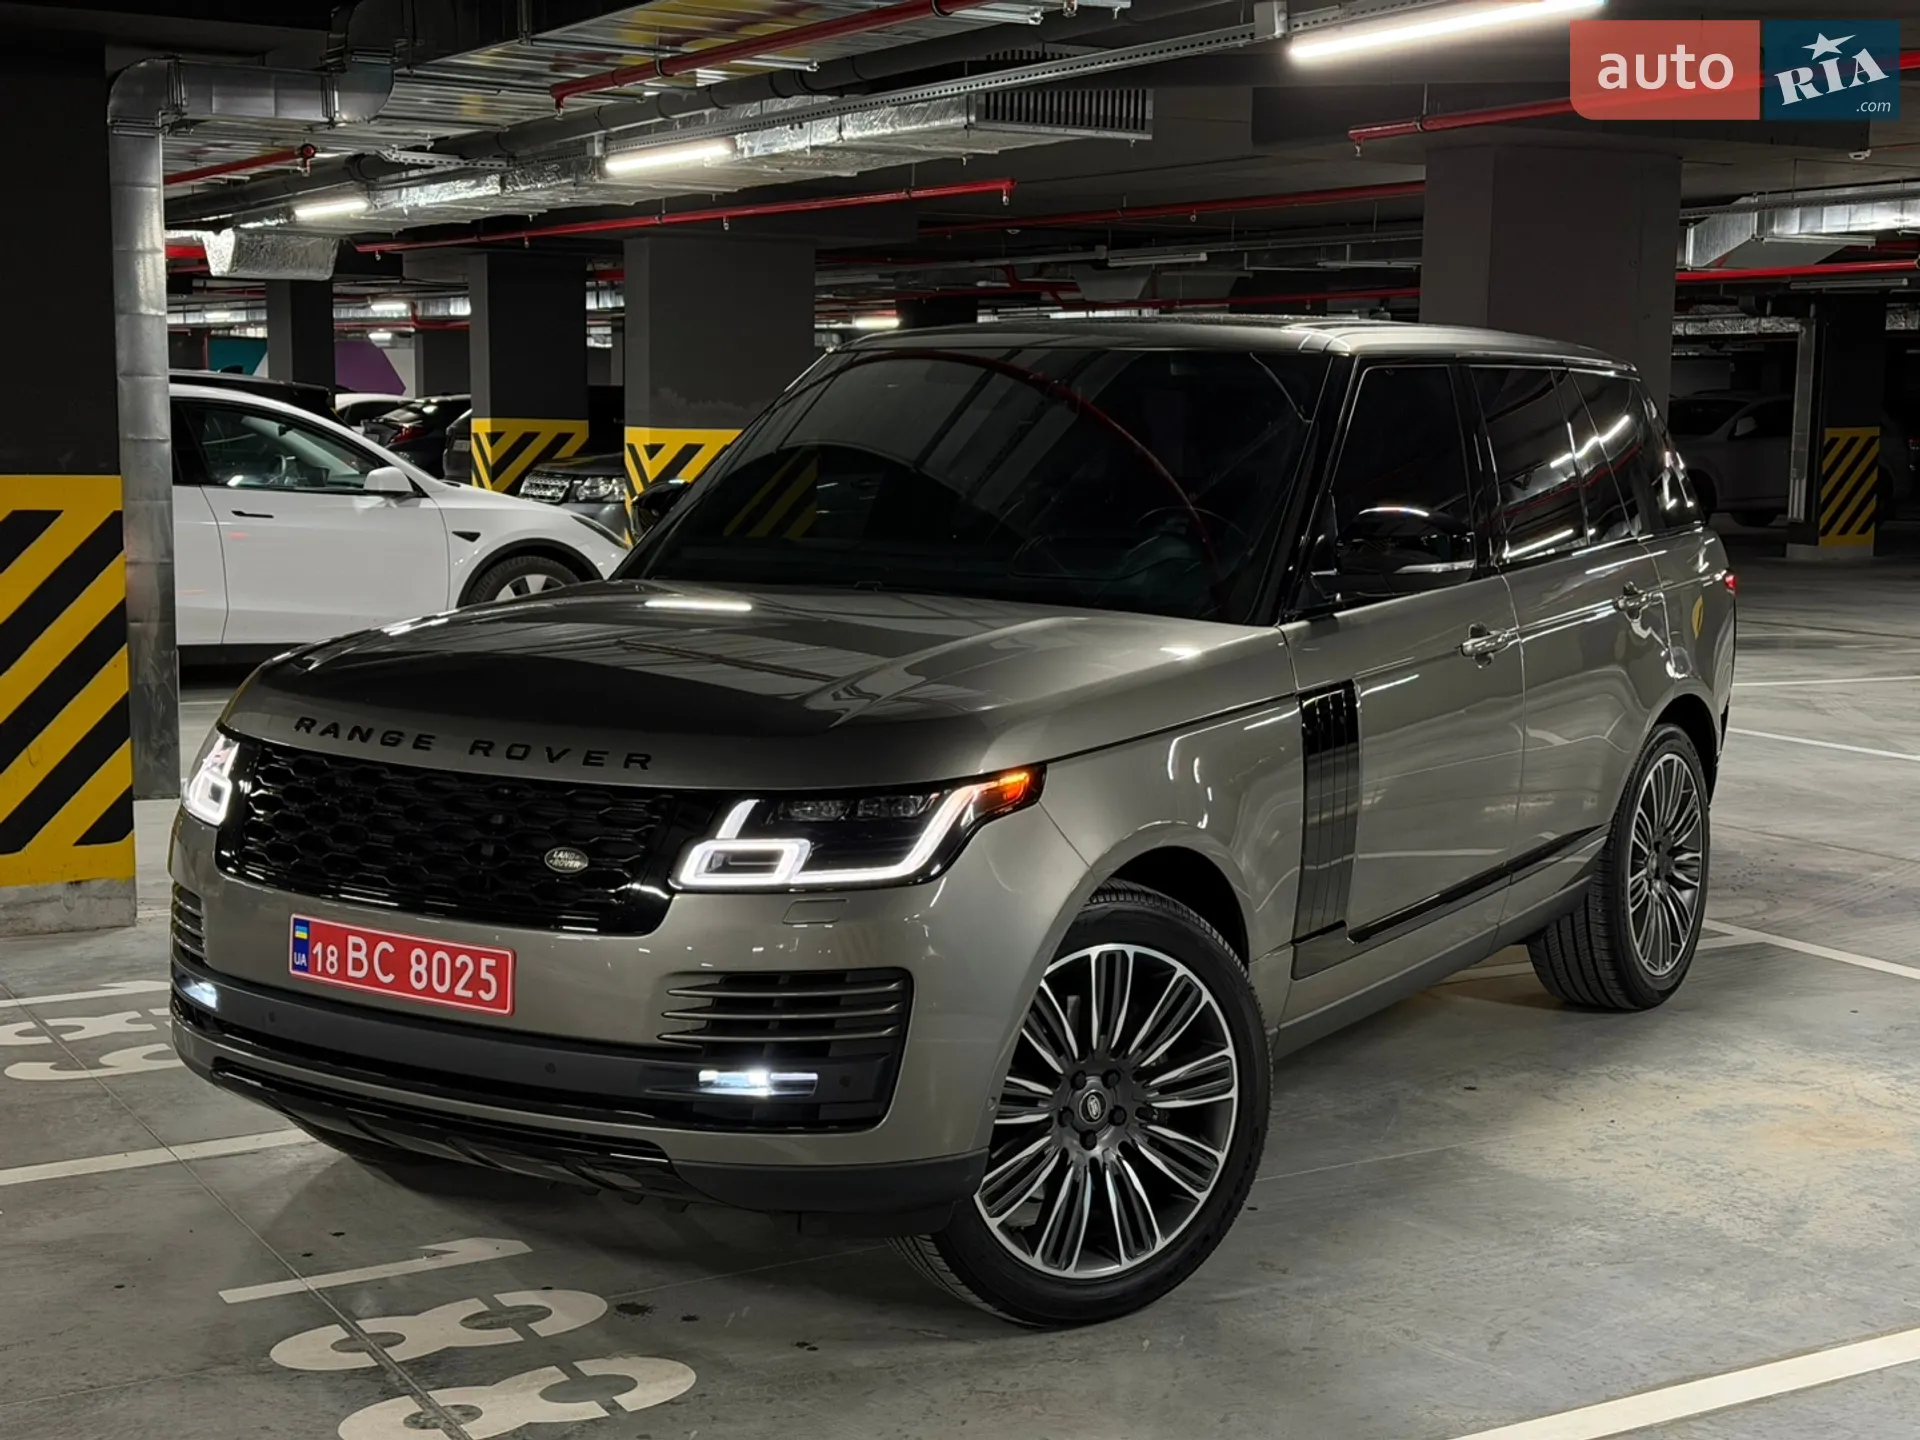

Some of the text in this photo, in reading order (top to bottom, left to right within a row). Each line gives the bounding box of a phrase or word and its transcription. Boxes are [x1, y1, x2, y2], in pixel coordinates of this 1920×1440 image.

[294, 716, 653, 771] RANGE ROVER
[553, 850, 576, 860] LAND
[551, 859, 582, 869] ROVER
[293, 952, 308, 967] UA
[312, 934, 498, 1002] 18 BC 8025
